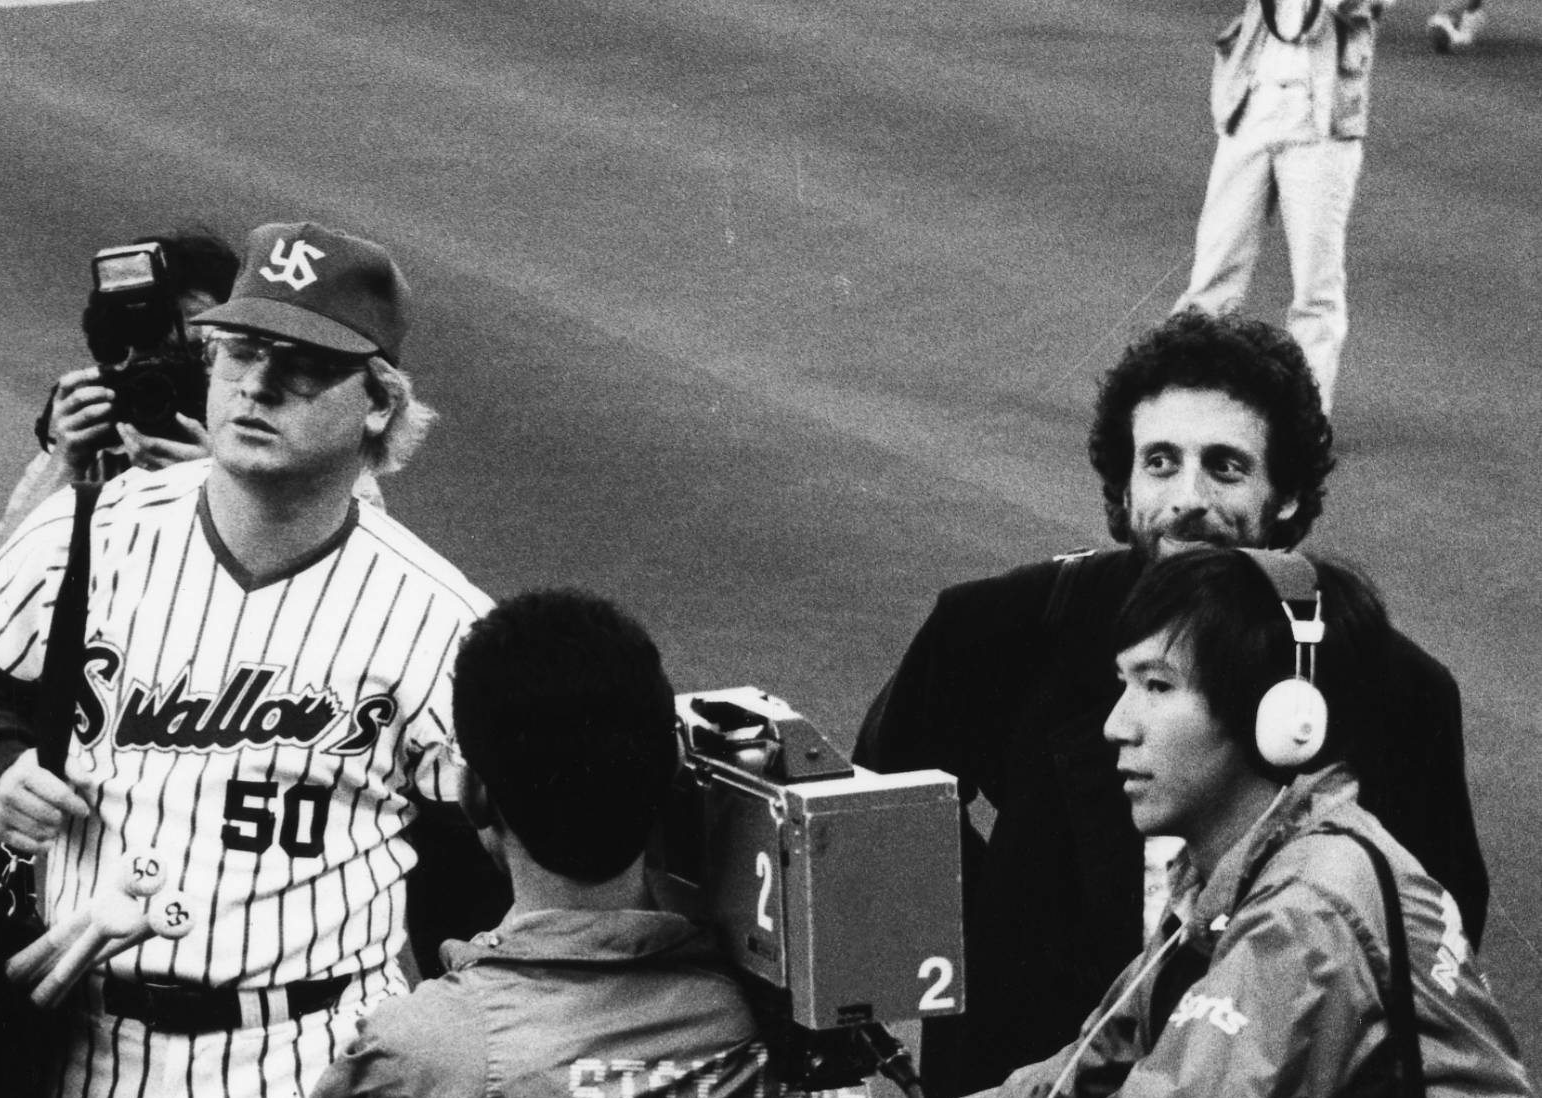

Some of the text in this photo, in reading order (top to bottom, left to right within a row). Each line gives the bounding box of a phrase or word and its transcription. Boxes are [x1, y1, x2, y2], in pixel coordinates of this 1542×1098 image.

[72, 640, 399, 756] Swallows
[221, 779, 333, 858] 50
[133, 856, 160, 882] 50
[756, 852, 774, 932] 2
[917, 956, 955, 1010] 2
